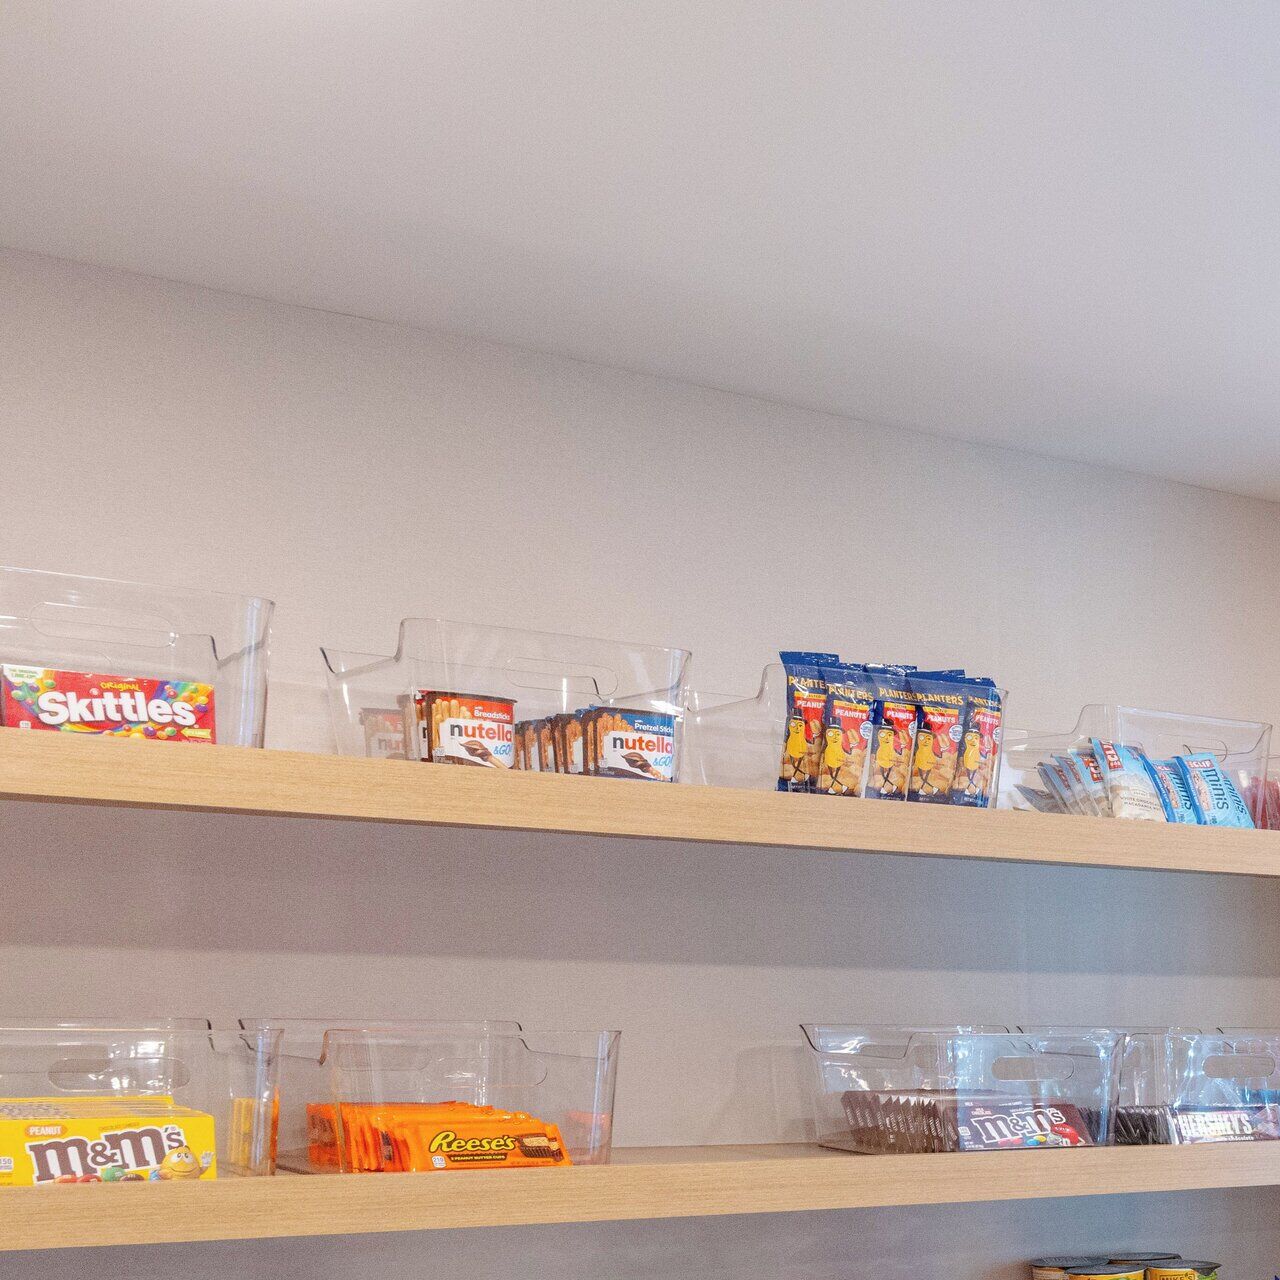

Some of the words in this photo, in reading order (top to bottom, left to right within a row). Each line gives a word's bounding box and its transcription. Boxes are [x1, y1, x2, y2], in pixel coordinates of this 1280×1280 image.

[37, 691, 197, 727] Skittles
[835, 708, 867, 719] PEANUTS
[886, 710, 914, 720] PEANUTS
[449, 720, 513, 739] nutella
[612, 733, 673, 755] nutella
[28, 1126, 63, 1136] PEANUT
[429, 1131, 517, 1153] Reese's
